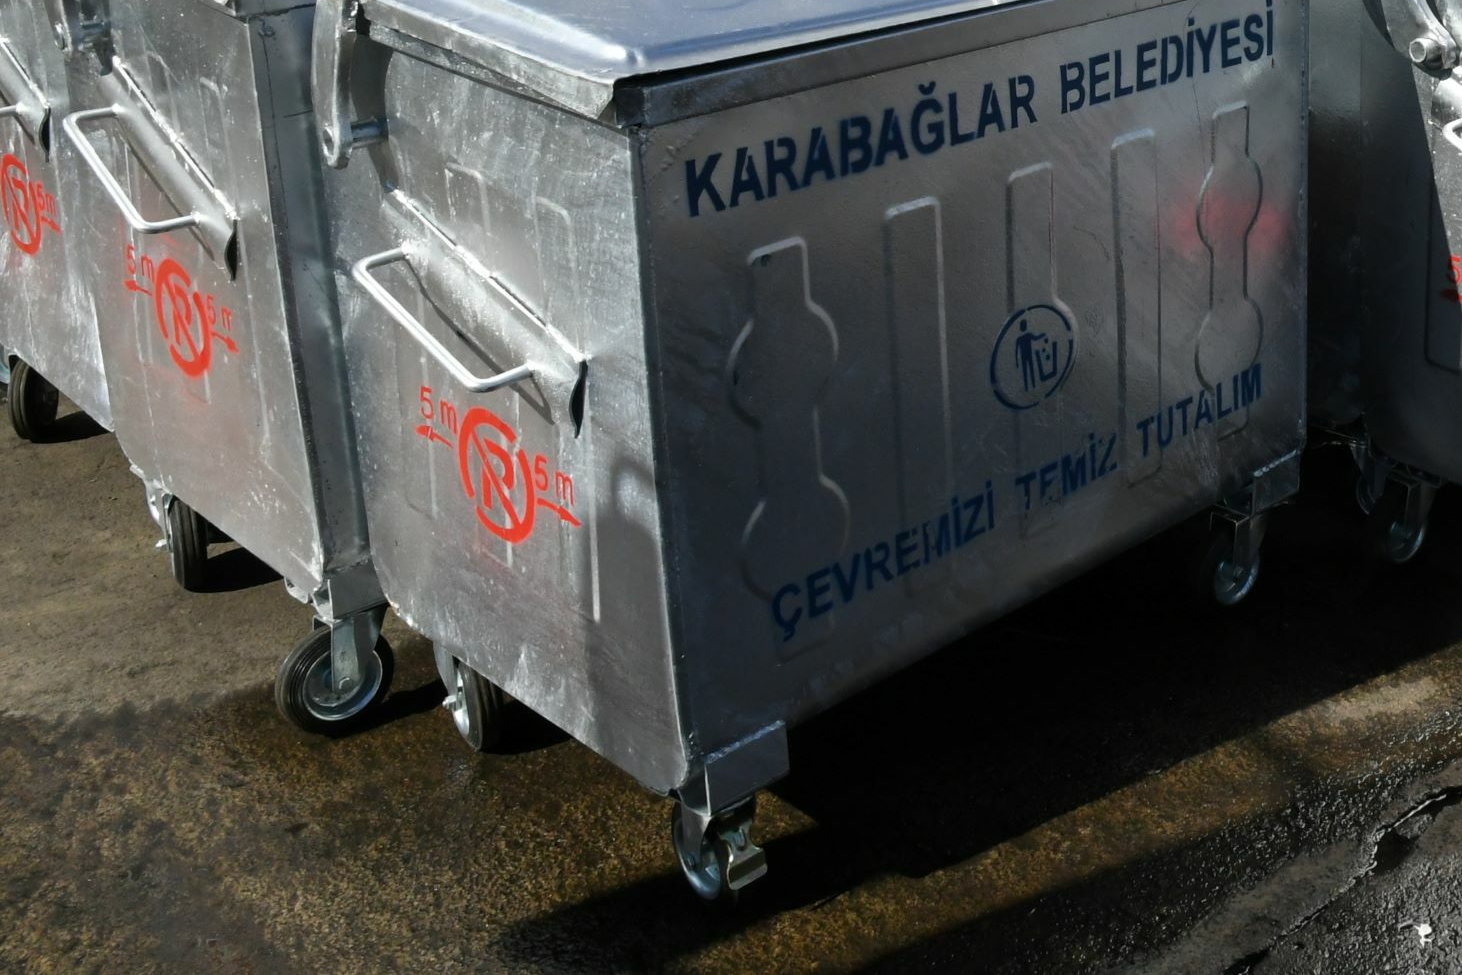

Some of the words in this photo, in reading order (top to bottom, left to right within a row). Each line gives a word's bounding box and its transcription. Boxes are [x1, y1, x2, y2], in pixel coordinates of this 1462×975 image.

[686, 74, 1038, 217] KARABAĞLAR
[534, 454, 549, 492] 5
[770, 479, 996, 642] ÇEVREMİZİ
[1015, 432, 1119, 512] TEMİZ
[1136, 362, 1263, 457] TUTALIM
